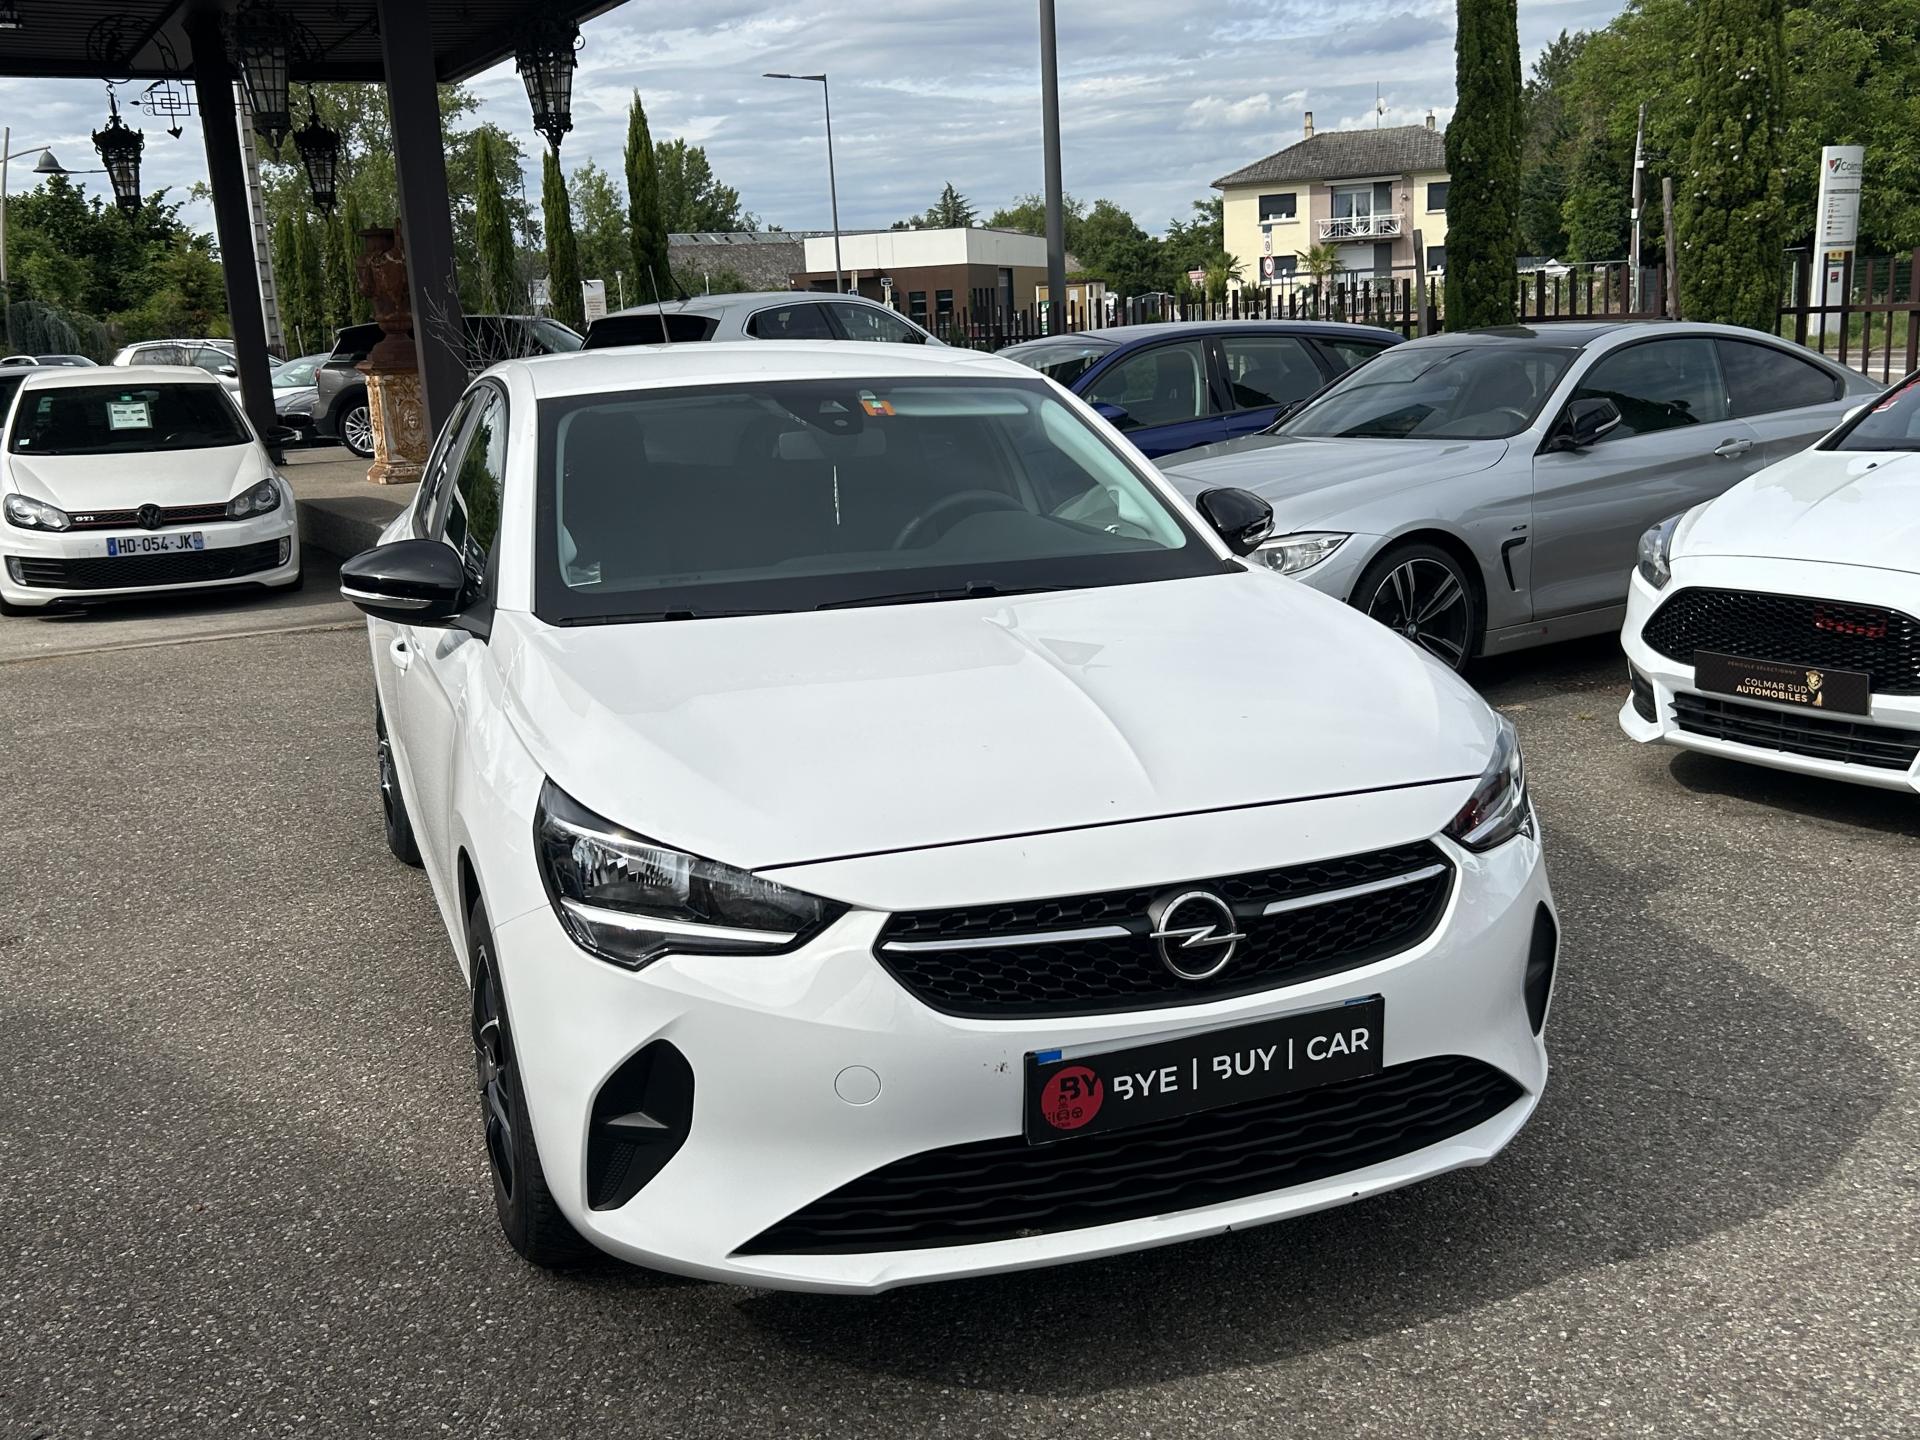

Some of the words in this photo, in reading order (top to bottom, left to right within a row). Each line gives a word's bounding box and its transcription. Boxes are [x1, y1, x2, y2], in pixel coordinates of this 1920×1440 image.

[118, 534, 193, 553] HD-054-JK
[1736, 684, 1808, 703] AUTOMOBILES
[1744, 677, 1785, 691] COLMAR
[1787, 683, 1808, 694] SUD
[1113, 1066, 1178, 1100] BYE
[1212, 1045, 1277, 1080] BUY
[1306, 1027, 1369, 1062] CAR
